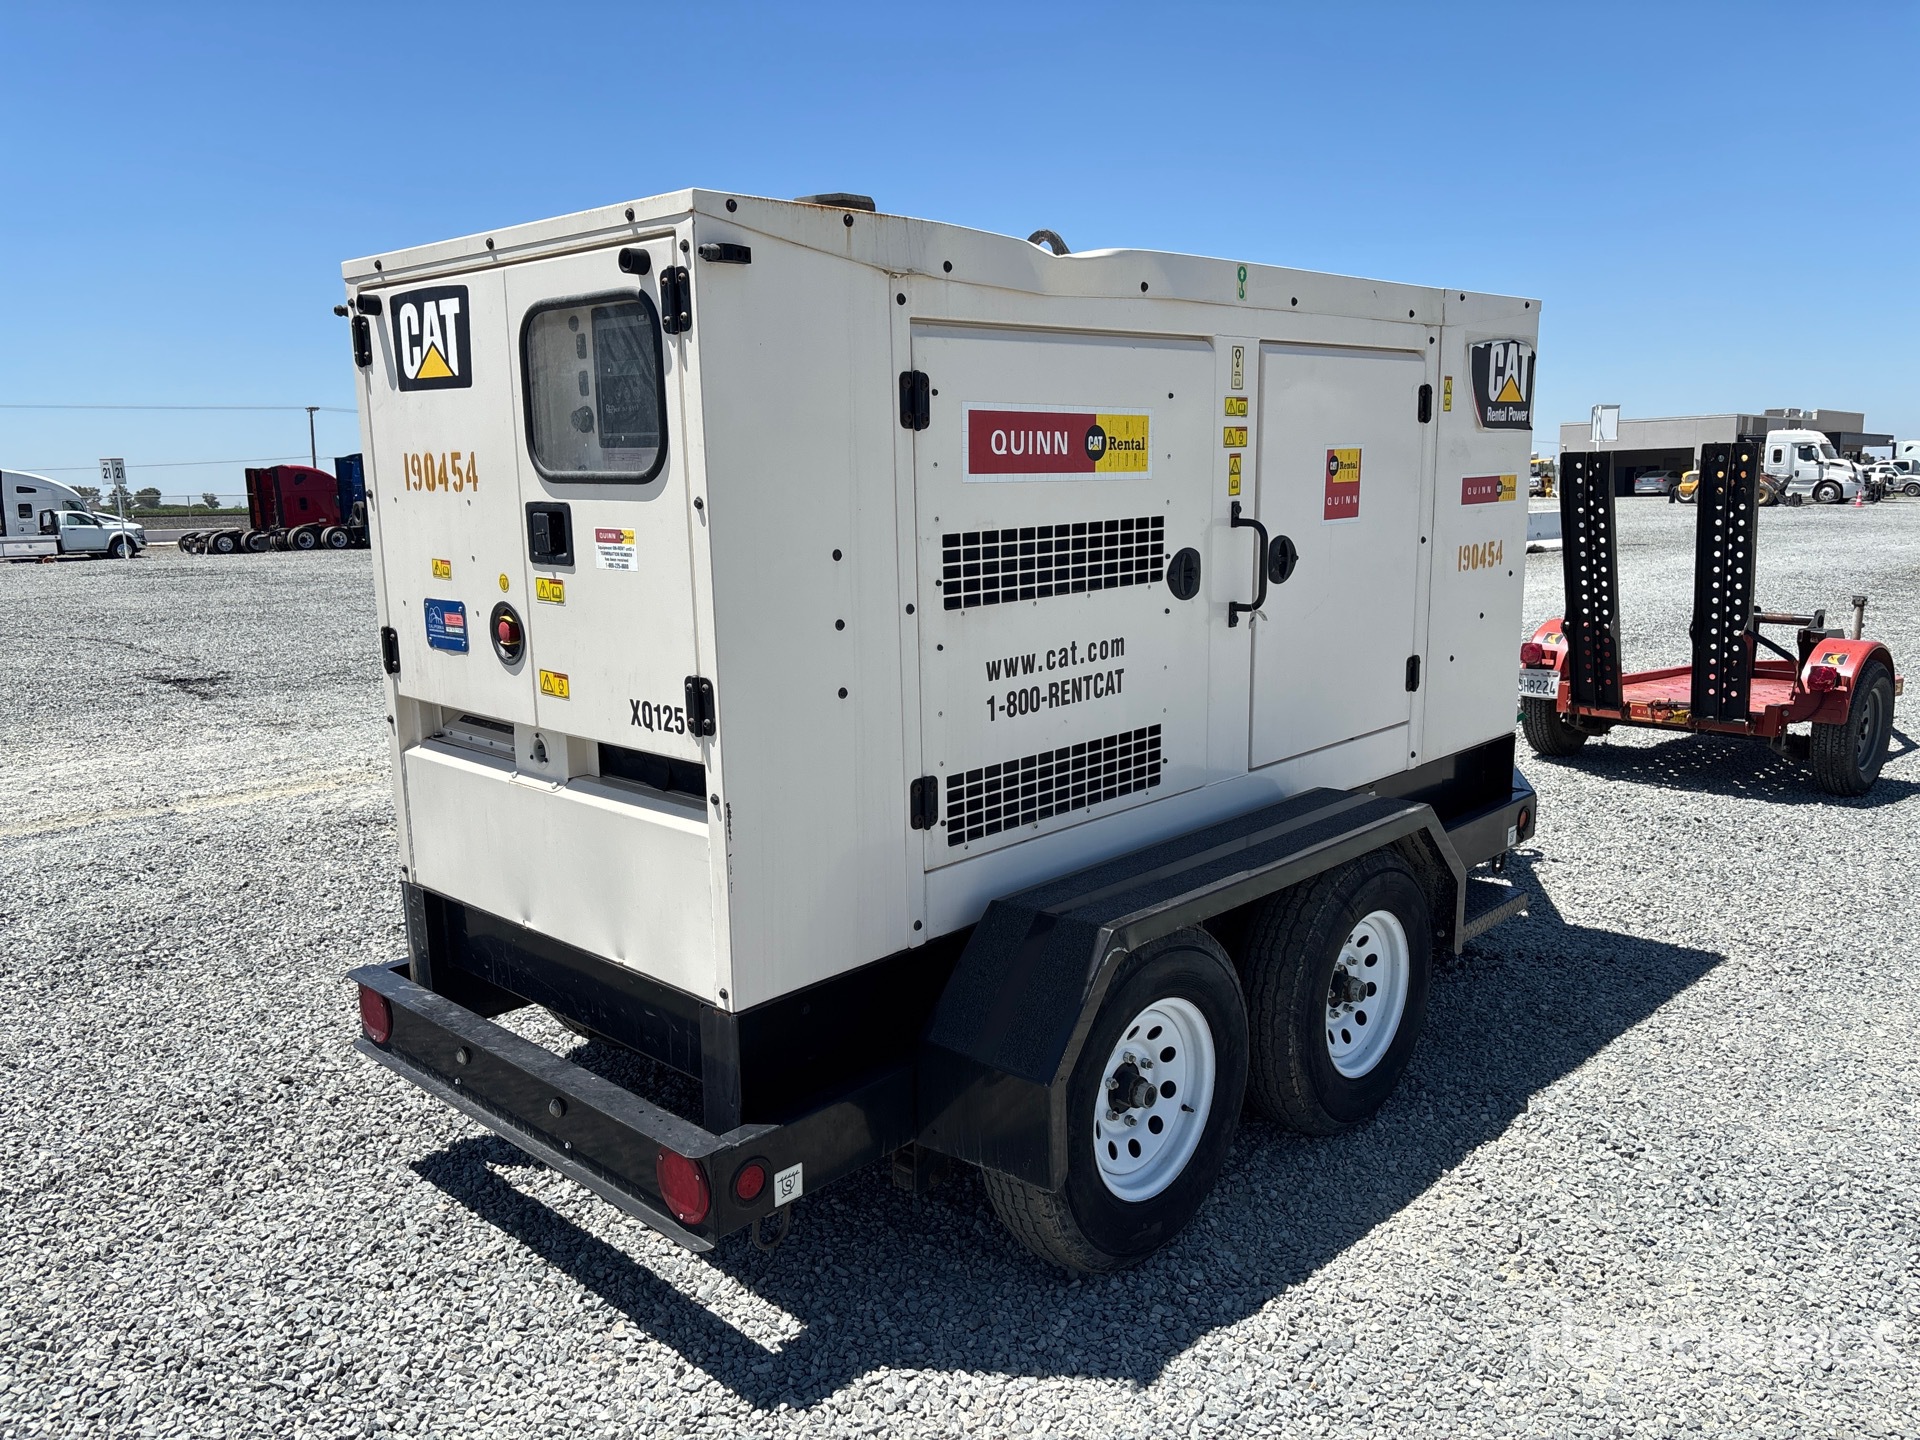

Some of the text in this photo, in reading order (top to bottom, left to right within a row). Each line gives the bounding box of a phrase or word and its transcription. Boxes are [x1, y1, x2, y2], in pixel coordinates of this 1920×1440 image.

[400, 297, 460, 380] CAT
[1488, 341, 1532, 402] CAT
[1486, 406, 1528, 422] Rental Power
[990, 430, 1069, 455] QUINN
[1088, 435, 1145, 451] CAT Rental
[103, 467, 111, 478] 21
[115, 467, 124, 479] 21
[404, 451, 479, 493] 190454
[1339, 461, 1358, 470] Rental
[1327, 495, 1358, 506] QUINN
[1467, 485, 1491, 495] QUINN
[1458, 540, 1503, 572] 190454
[986, 637, 1125, 681] www.cat.com
[987, 668, 1125, 722] 1-800-RENTCAT
[629, 699, 685, 735] XQ125
